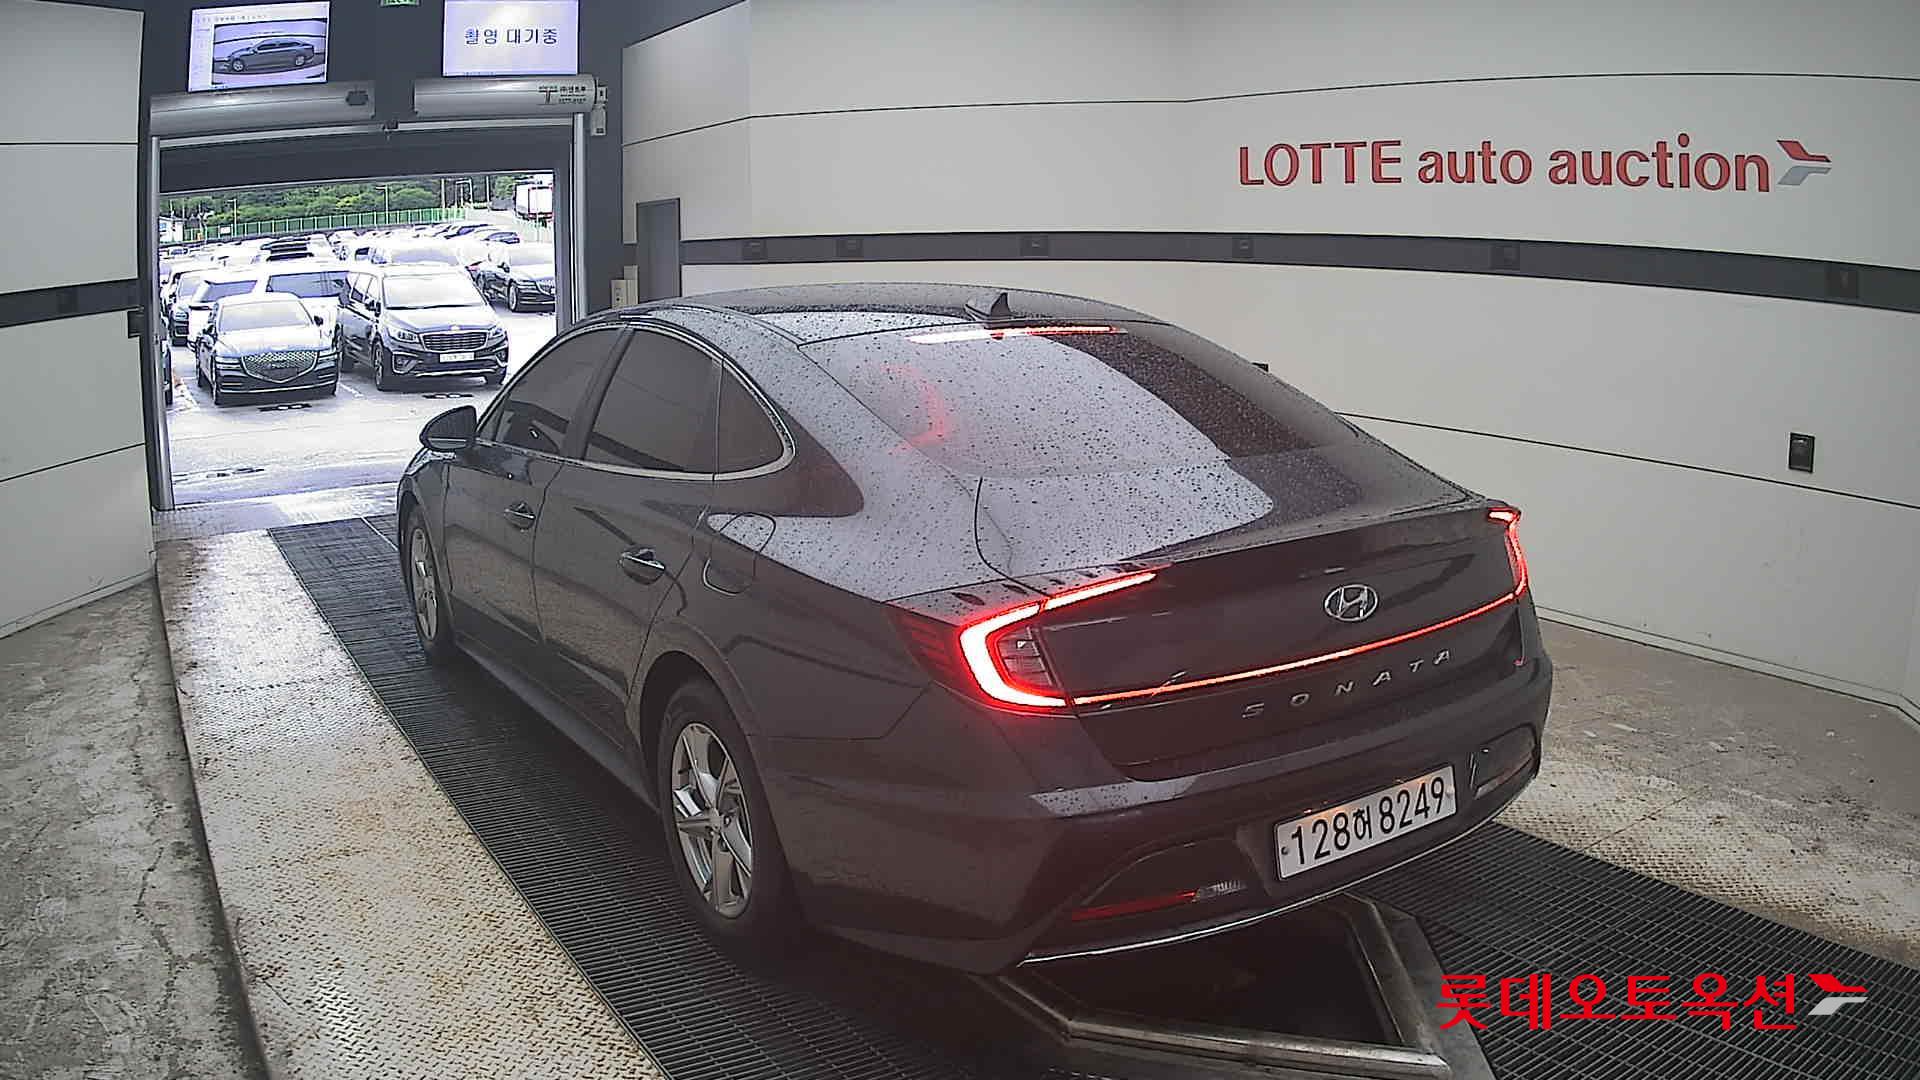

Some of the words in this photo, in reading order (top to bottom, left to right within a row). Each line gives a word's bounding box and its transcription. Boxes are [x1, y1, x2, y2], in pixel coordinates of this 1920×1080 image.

[506, 27, 558, 45] 대기중
[1239, 140, 1401, 186] LOTTE
[1418, 141, 1532, 184] auto
[1548, 133, 1769, 192] auction
[1242, 649, 1451, 718] SONATA
[1379, 776, 1445, 835] 8249
